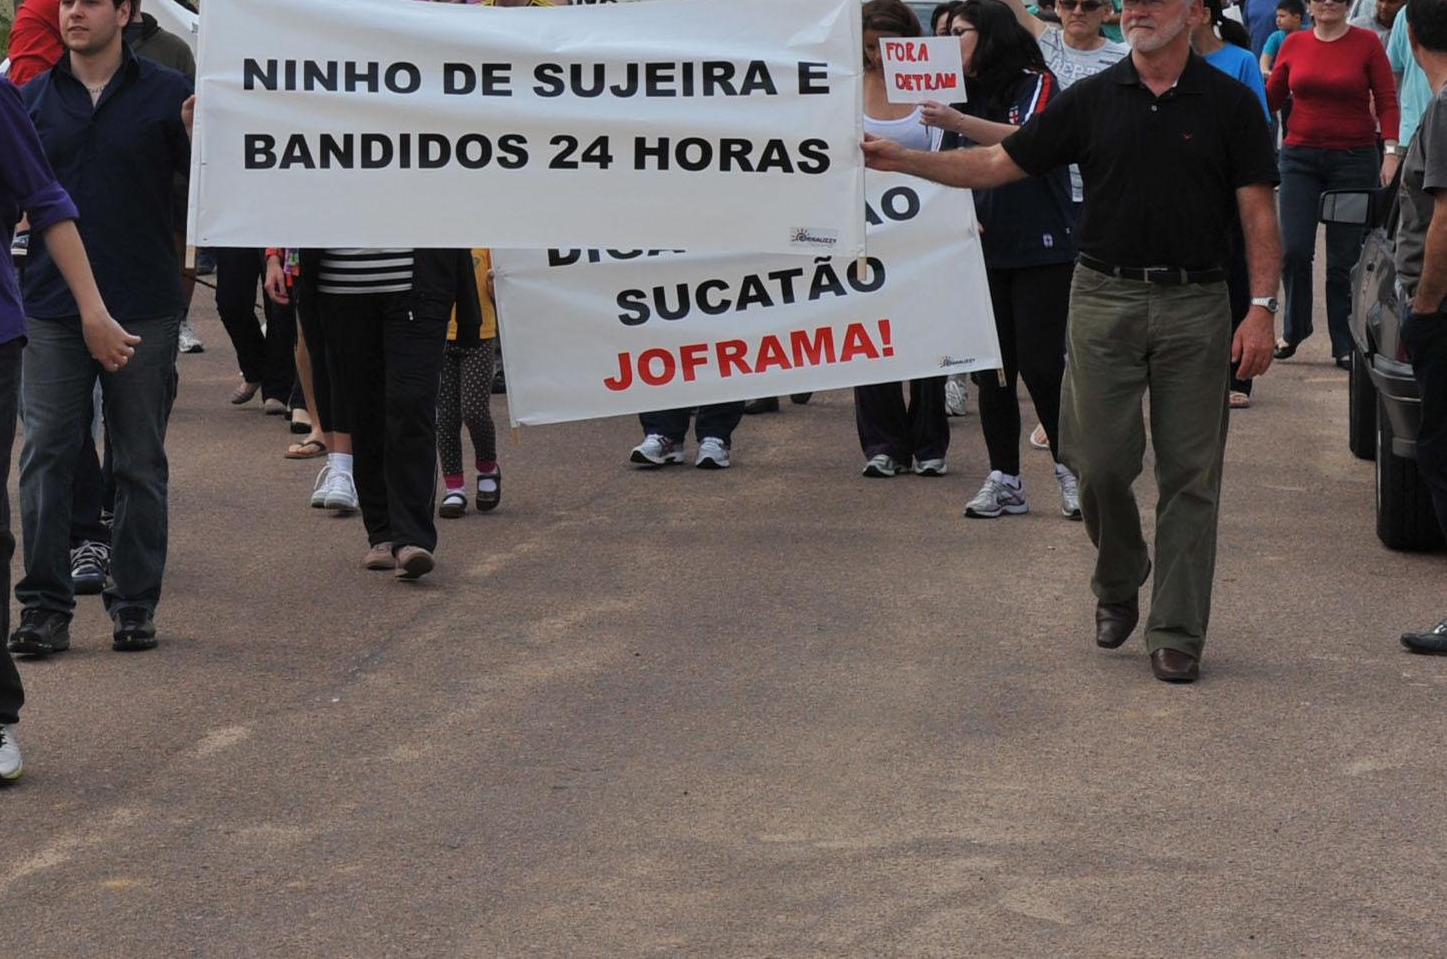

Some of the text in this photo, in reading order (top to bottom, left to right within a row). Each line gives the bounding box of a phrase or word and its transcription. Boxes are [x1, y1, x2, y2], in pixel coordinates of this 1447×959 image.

[885, 42, 929, 62] FORA
[242, 58, 831, 98] NINHO DE SUJEIRA E
[244, 133, 831, 175] BANDIDOS 24 HORAS
[616, 254, 887, 327] SUCATÃO
[602, 319, 895, 392] JOFRAMA!
